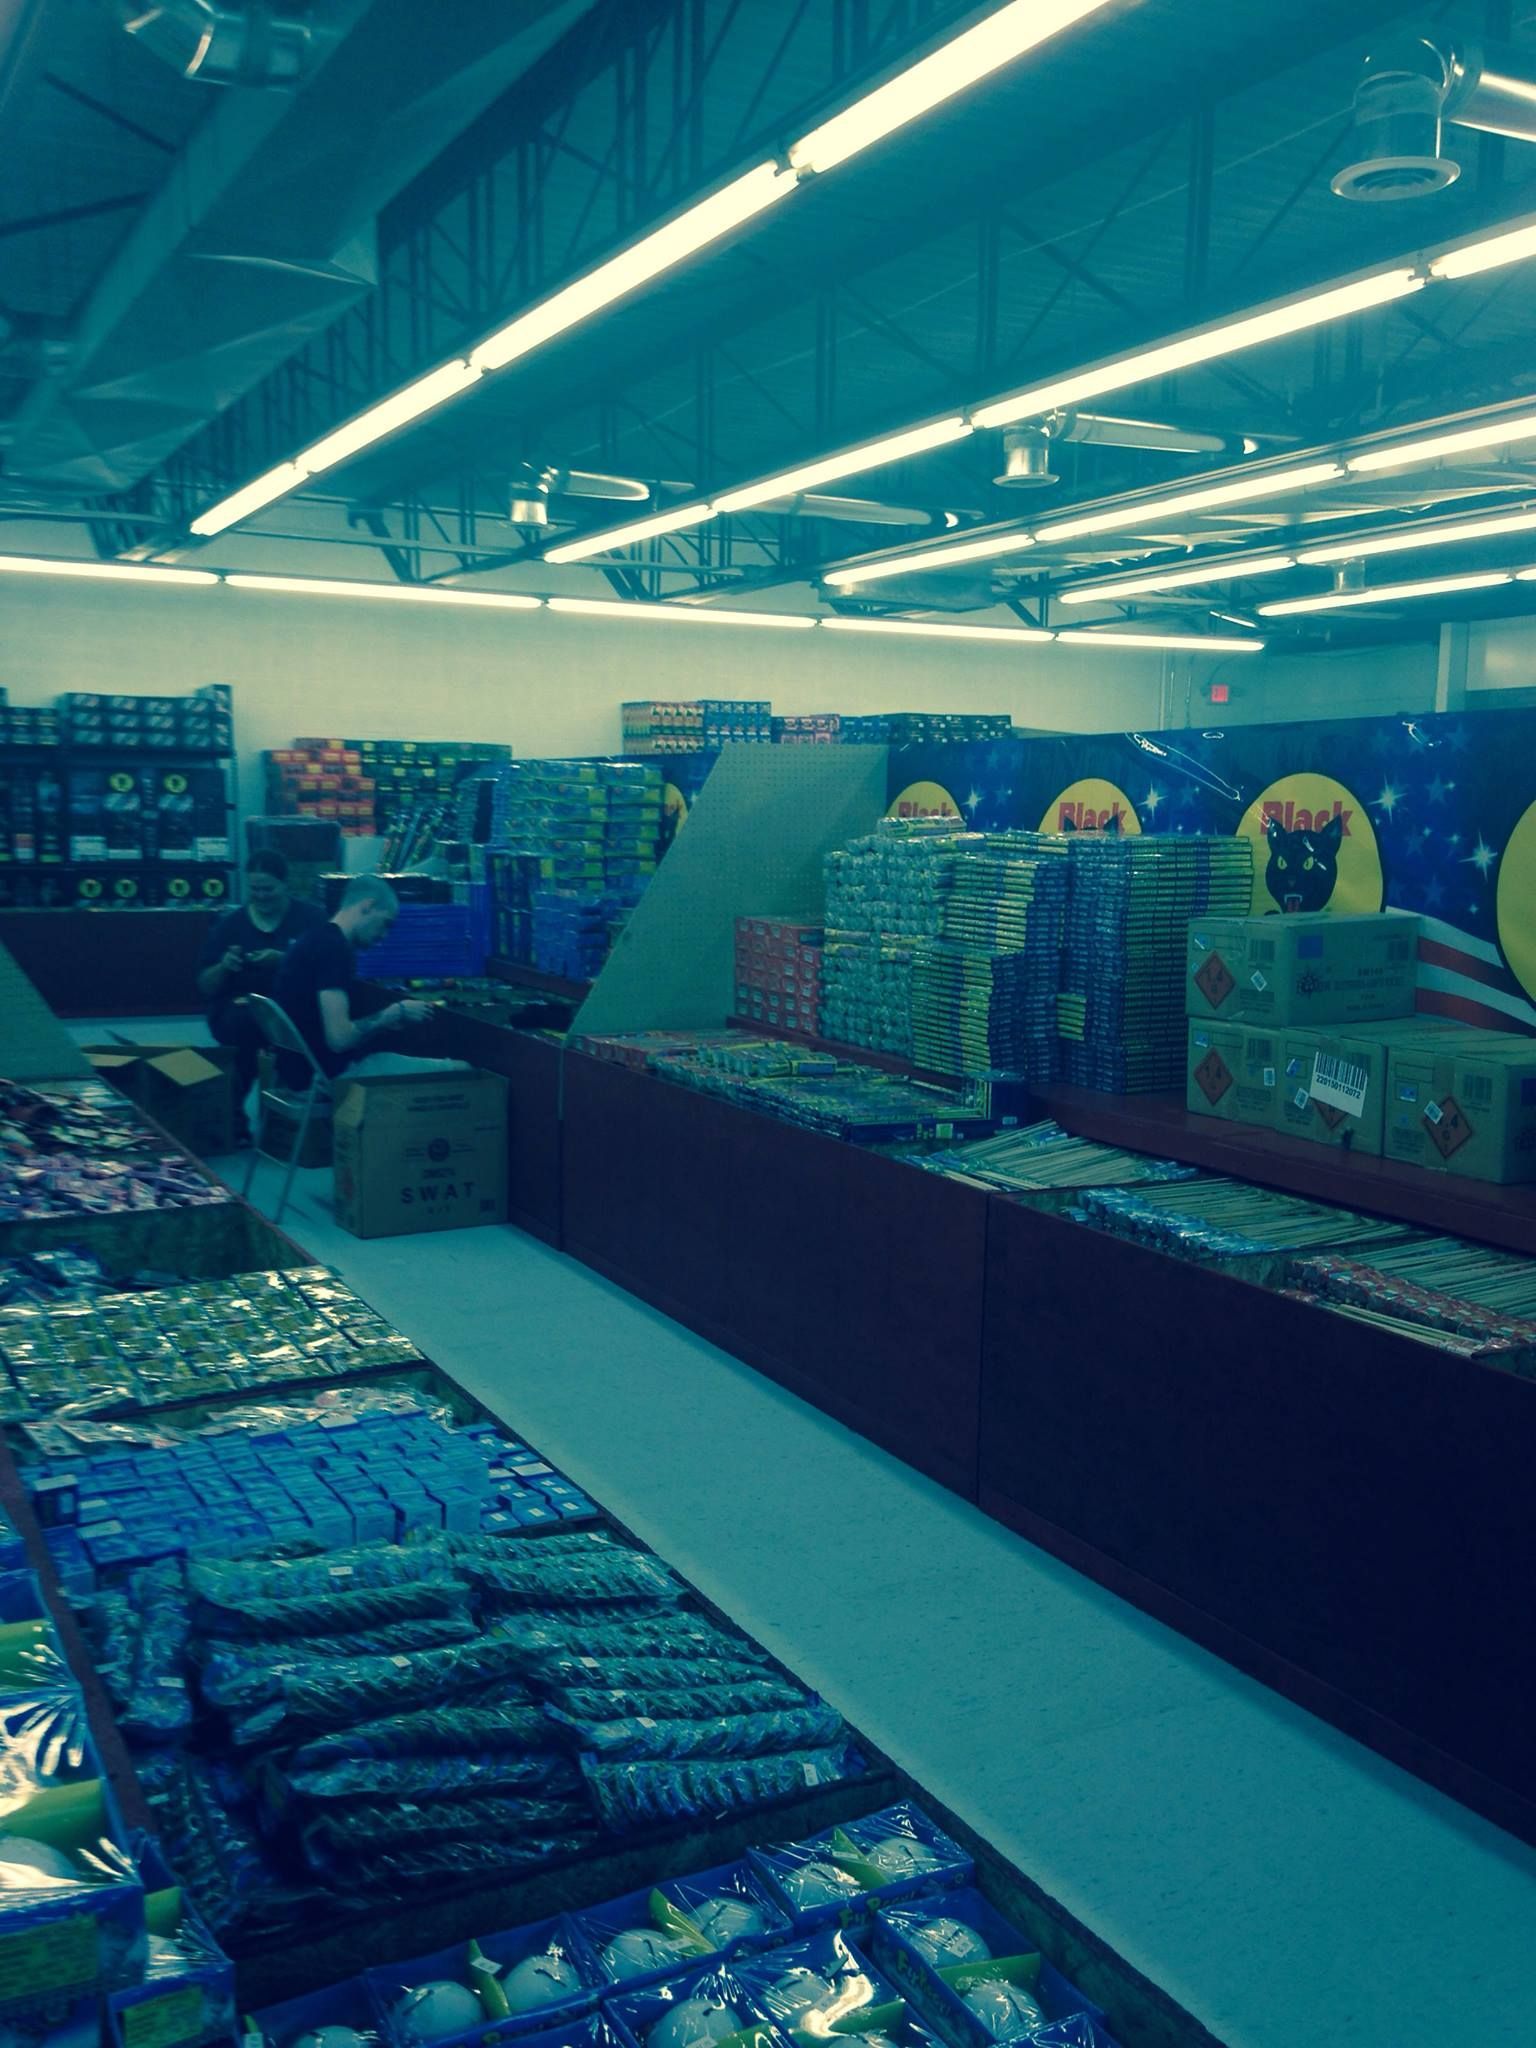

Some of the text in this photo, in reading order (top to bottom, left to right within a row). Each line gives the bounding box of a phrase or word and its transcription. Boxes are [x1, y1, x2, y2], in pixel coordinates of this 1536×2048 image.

[1058, 803, 1127, 833] Black
[1260, 801, 1353, 836] Black
[1316, 1074, 1361, 1099] 220150112072
[401, 1182, 475, 1204] SWAT
